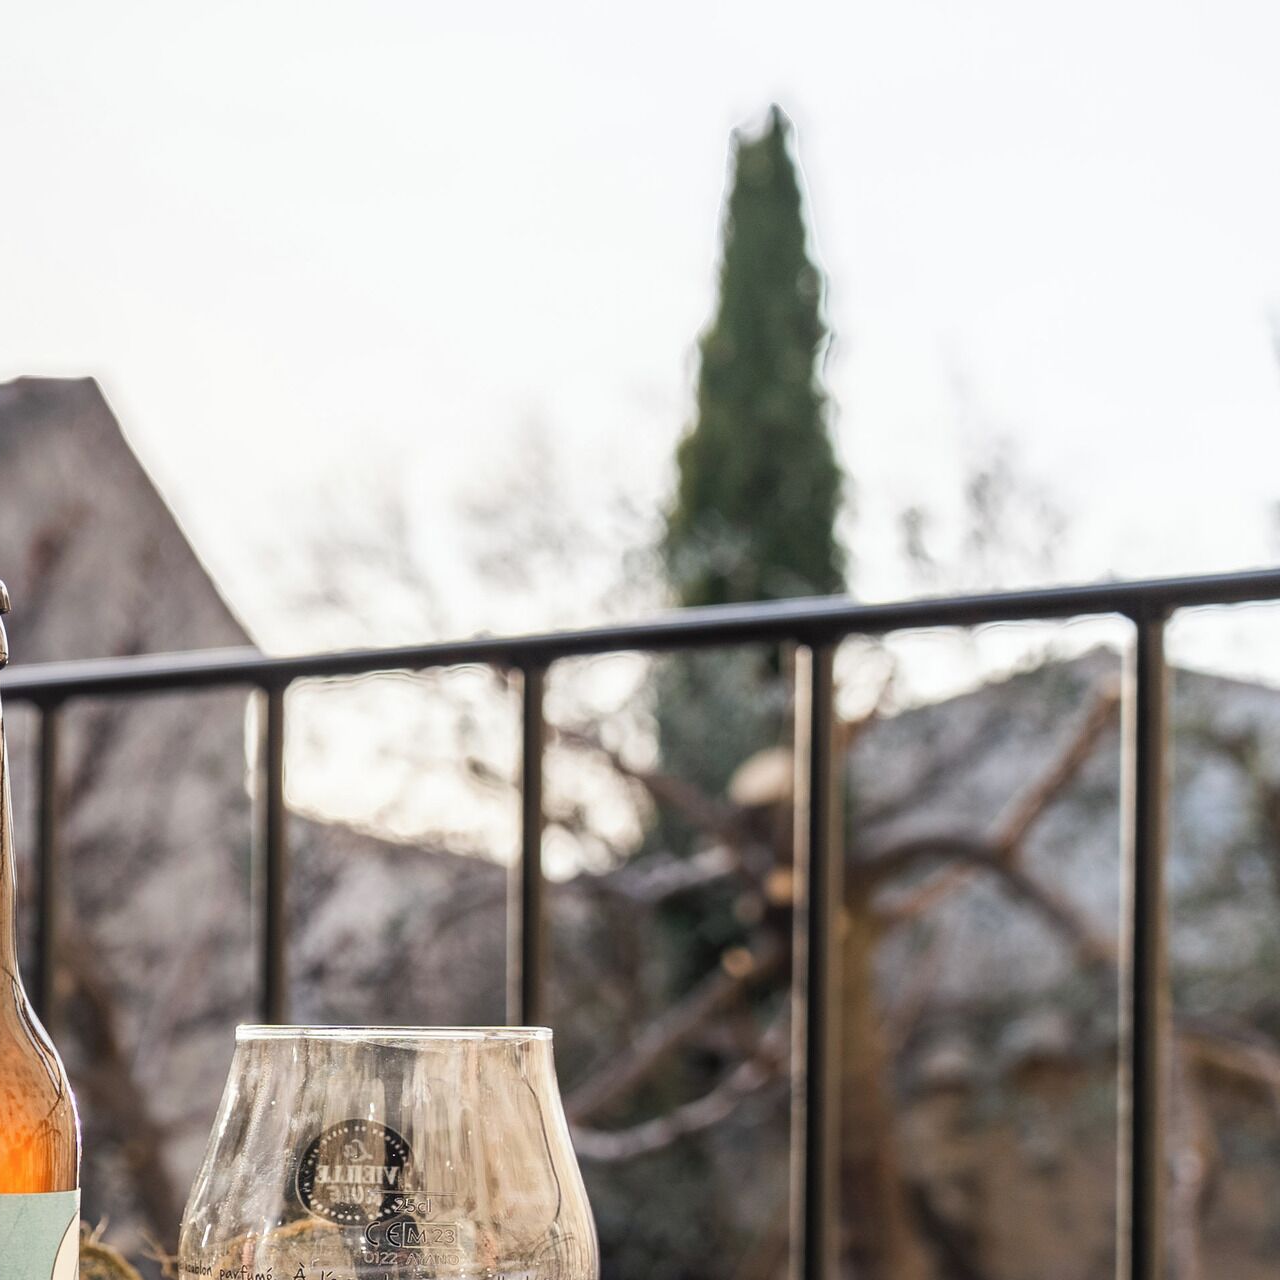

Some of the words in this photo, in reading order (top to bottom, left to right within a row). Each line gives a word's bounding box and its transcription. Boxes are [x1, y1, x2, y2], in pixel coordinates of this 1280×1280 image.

[395, 1197, 432, 1214] 25cl
[407, 1228, 427, 1244] M
[432, 1228, 455, 1244] 23
[363, 1252, 398, 1265] 0122
